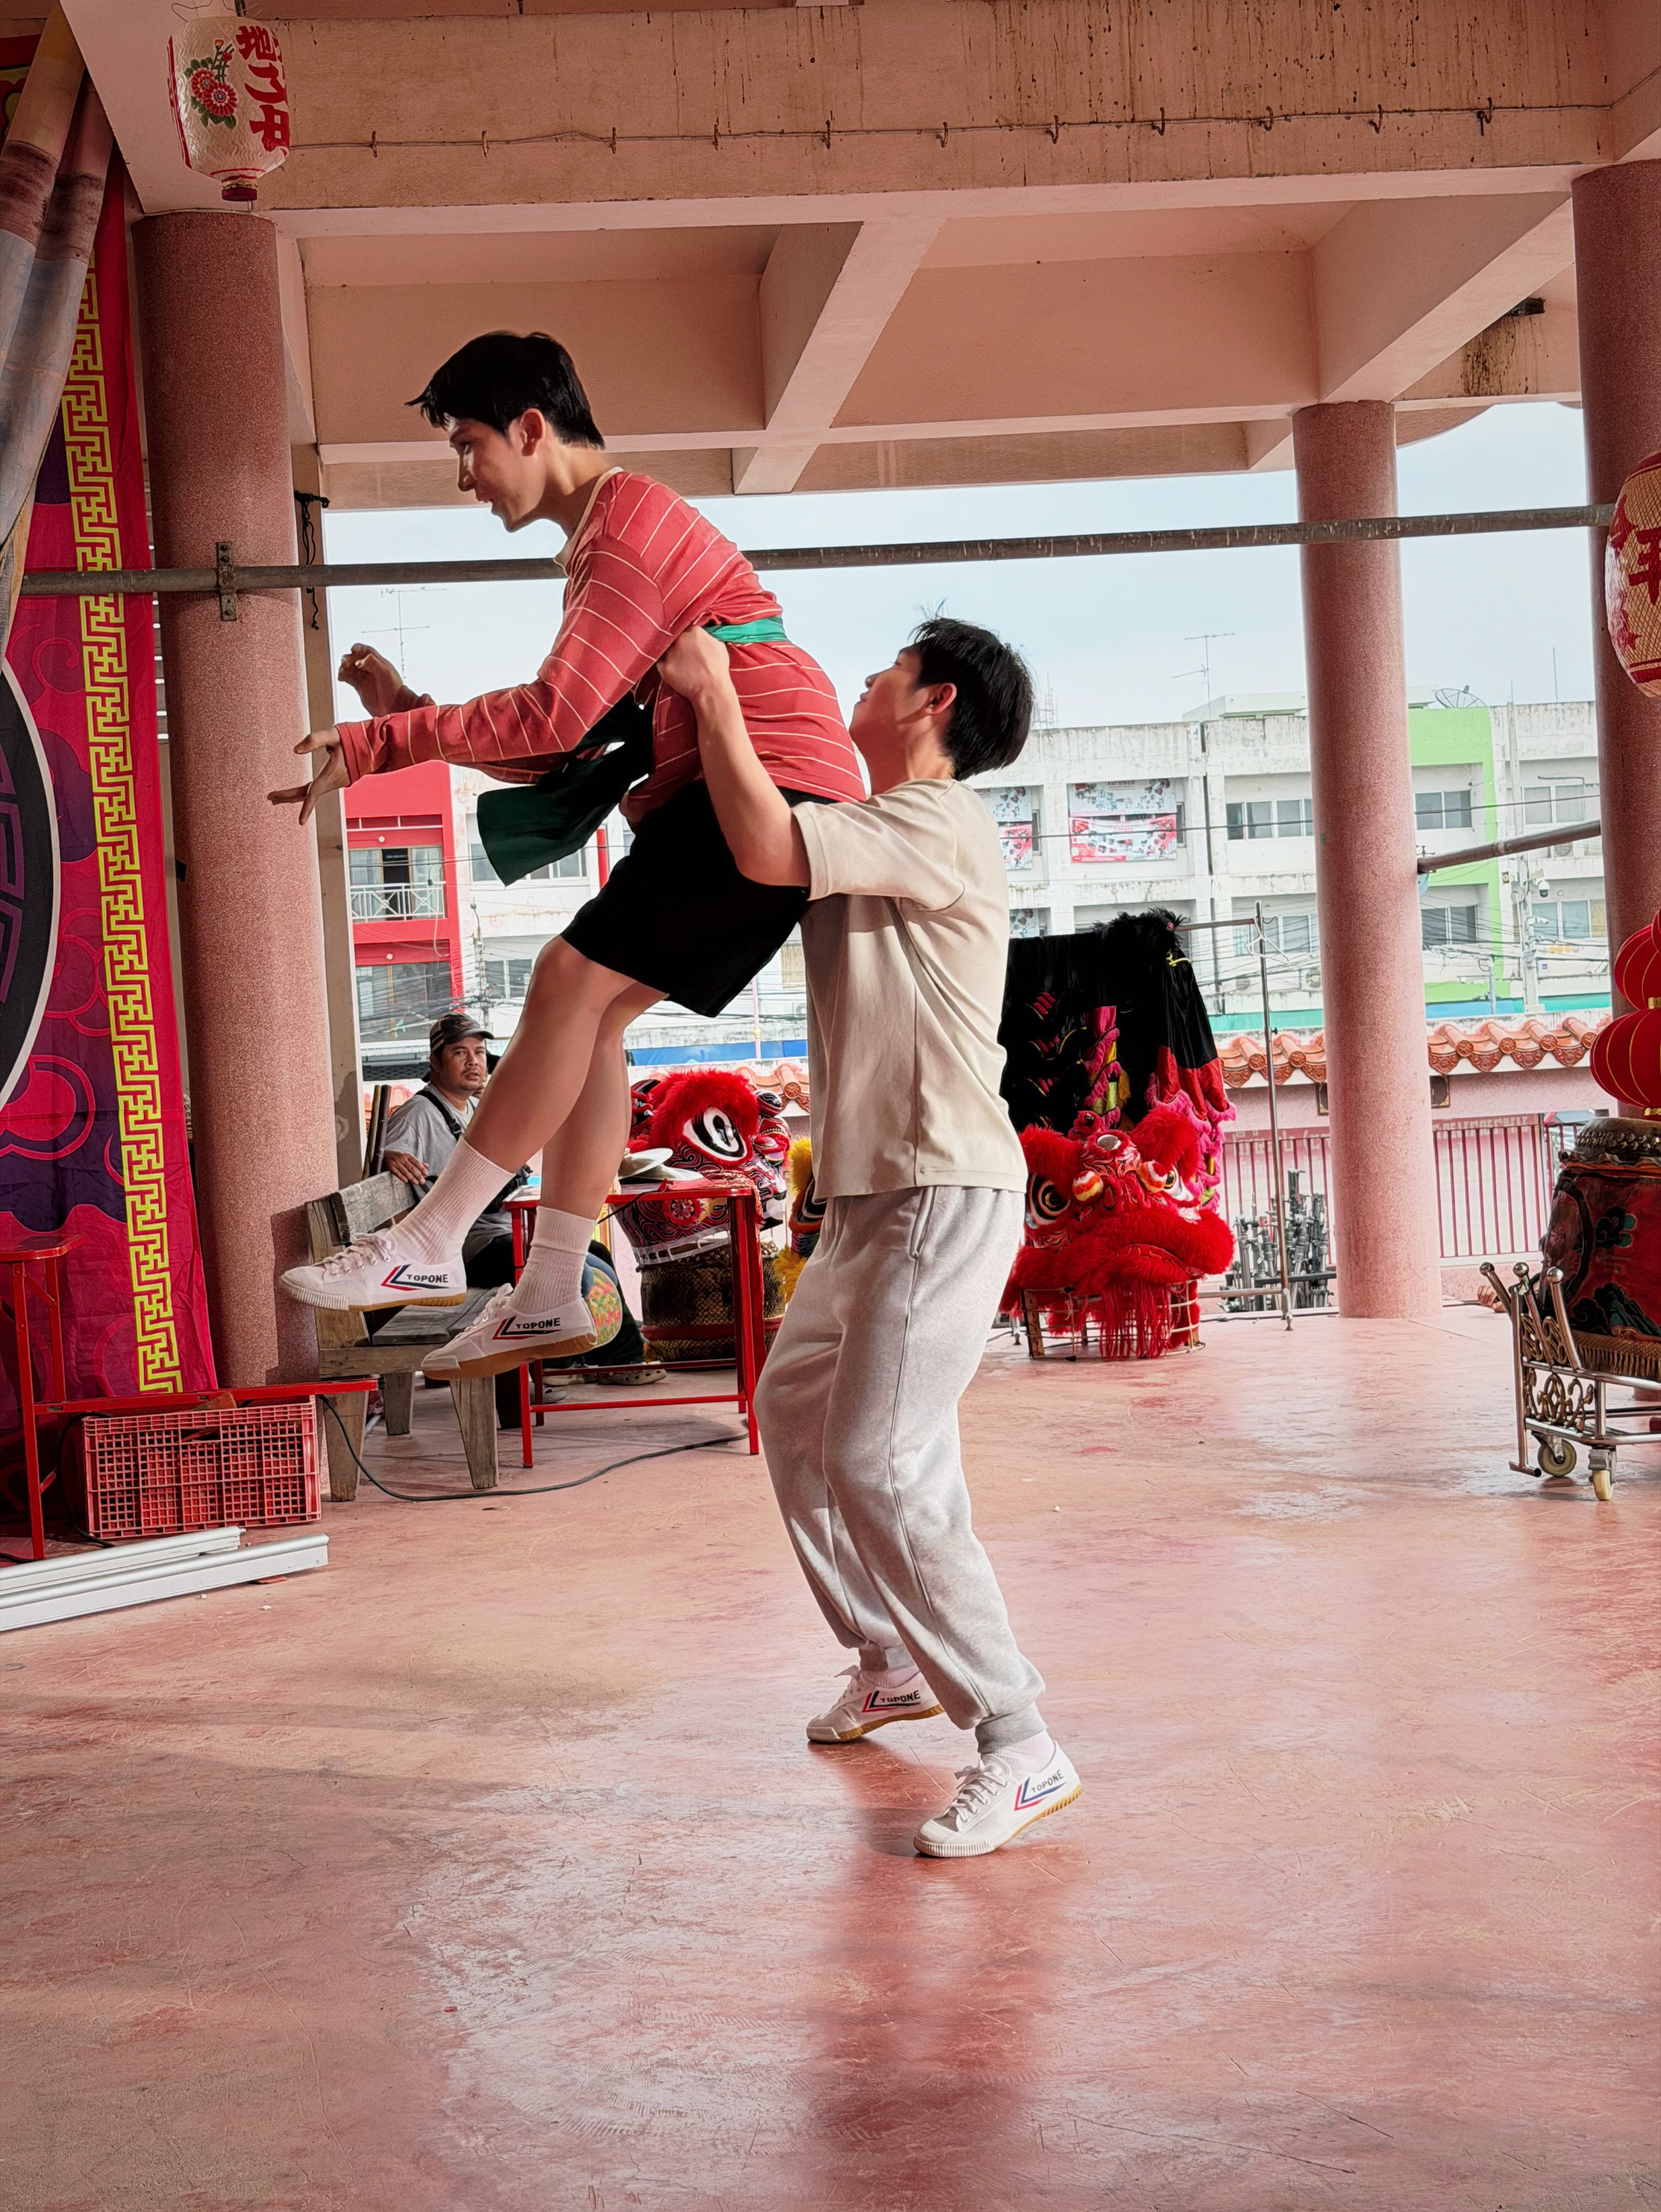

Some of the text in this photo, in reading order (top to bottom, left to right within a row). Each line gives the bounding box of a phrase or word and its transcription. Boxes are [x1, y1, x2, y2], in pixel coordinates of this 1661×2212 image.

[406, 1274, 449, 1283] TOPONE
[515, 1317, 561, 1329] TOPONE
[880, 1689, 921, 1703] TOPONE
[1030, 1769, 1064, 1793] TOPONE
